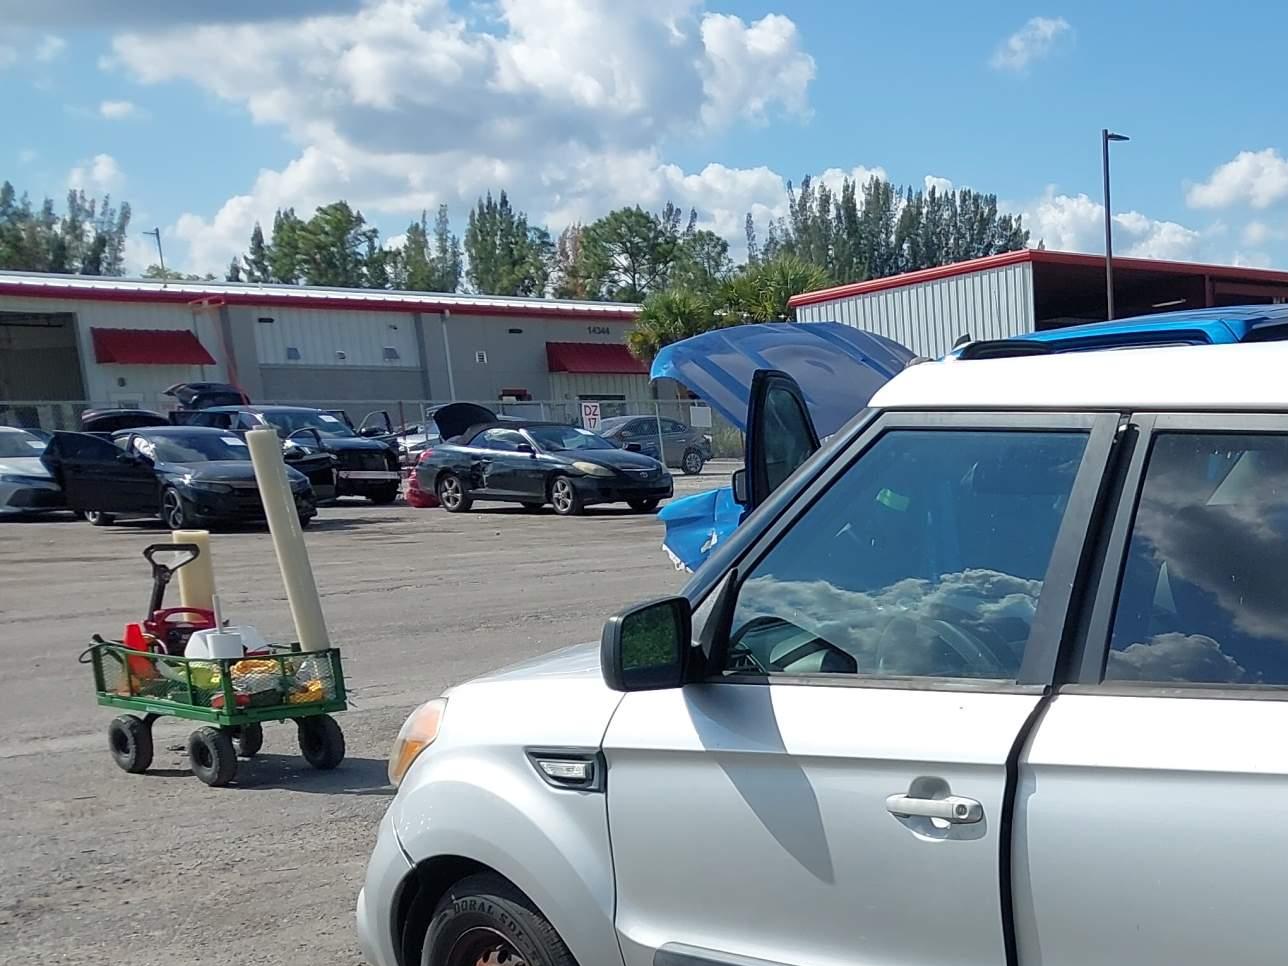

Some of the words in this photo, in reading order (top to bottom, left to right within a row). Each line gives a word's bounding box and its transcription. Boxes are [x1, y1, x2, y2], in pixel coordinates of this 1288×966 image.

[583, 404, 599, 416] DZ
[588, 417, 597, 429] 17
[455, 899, 495, 915] DORAL
